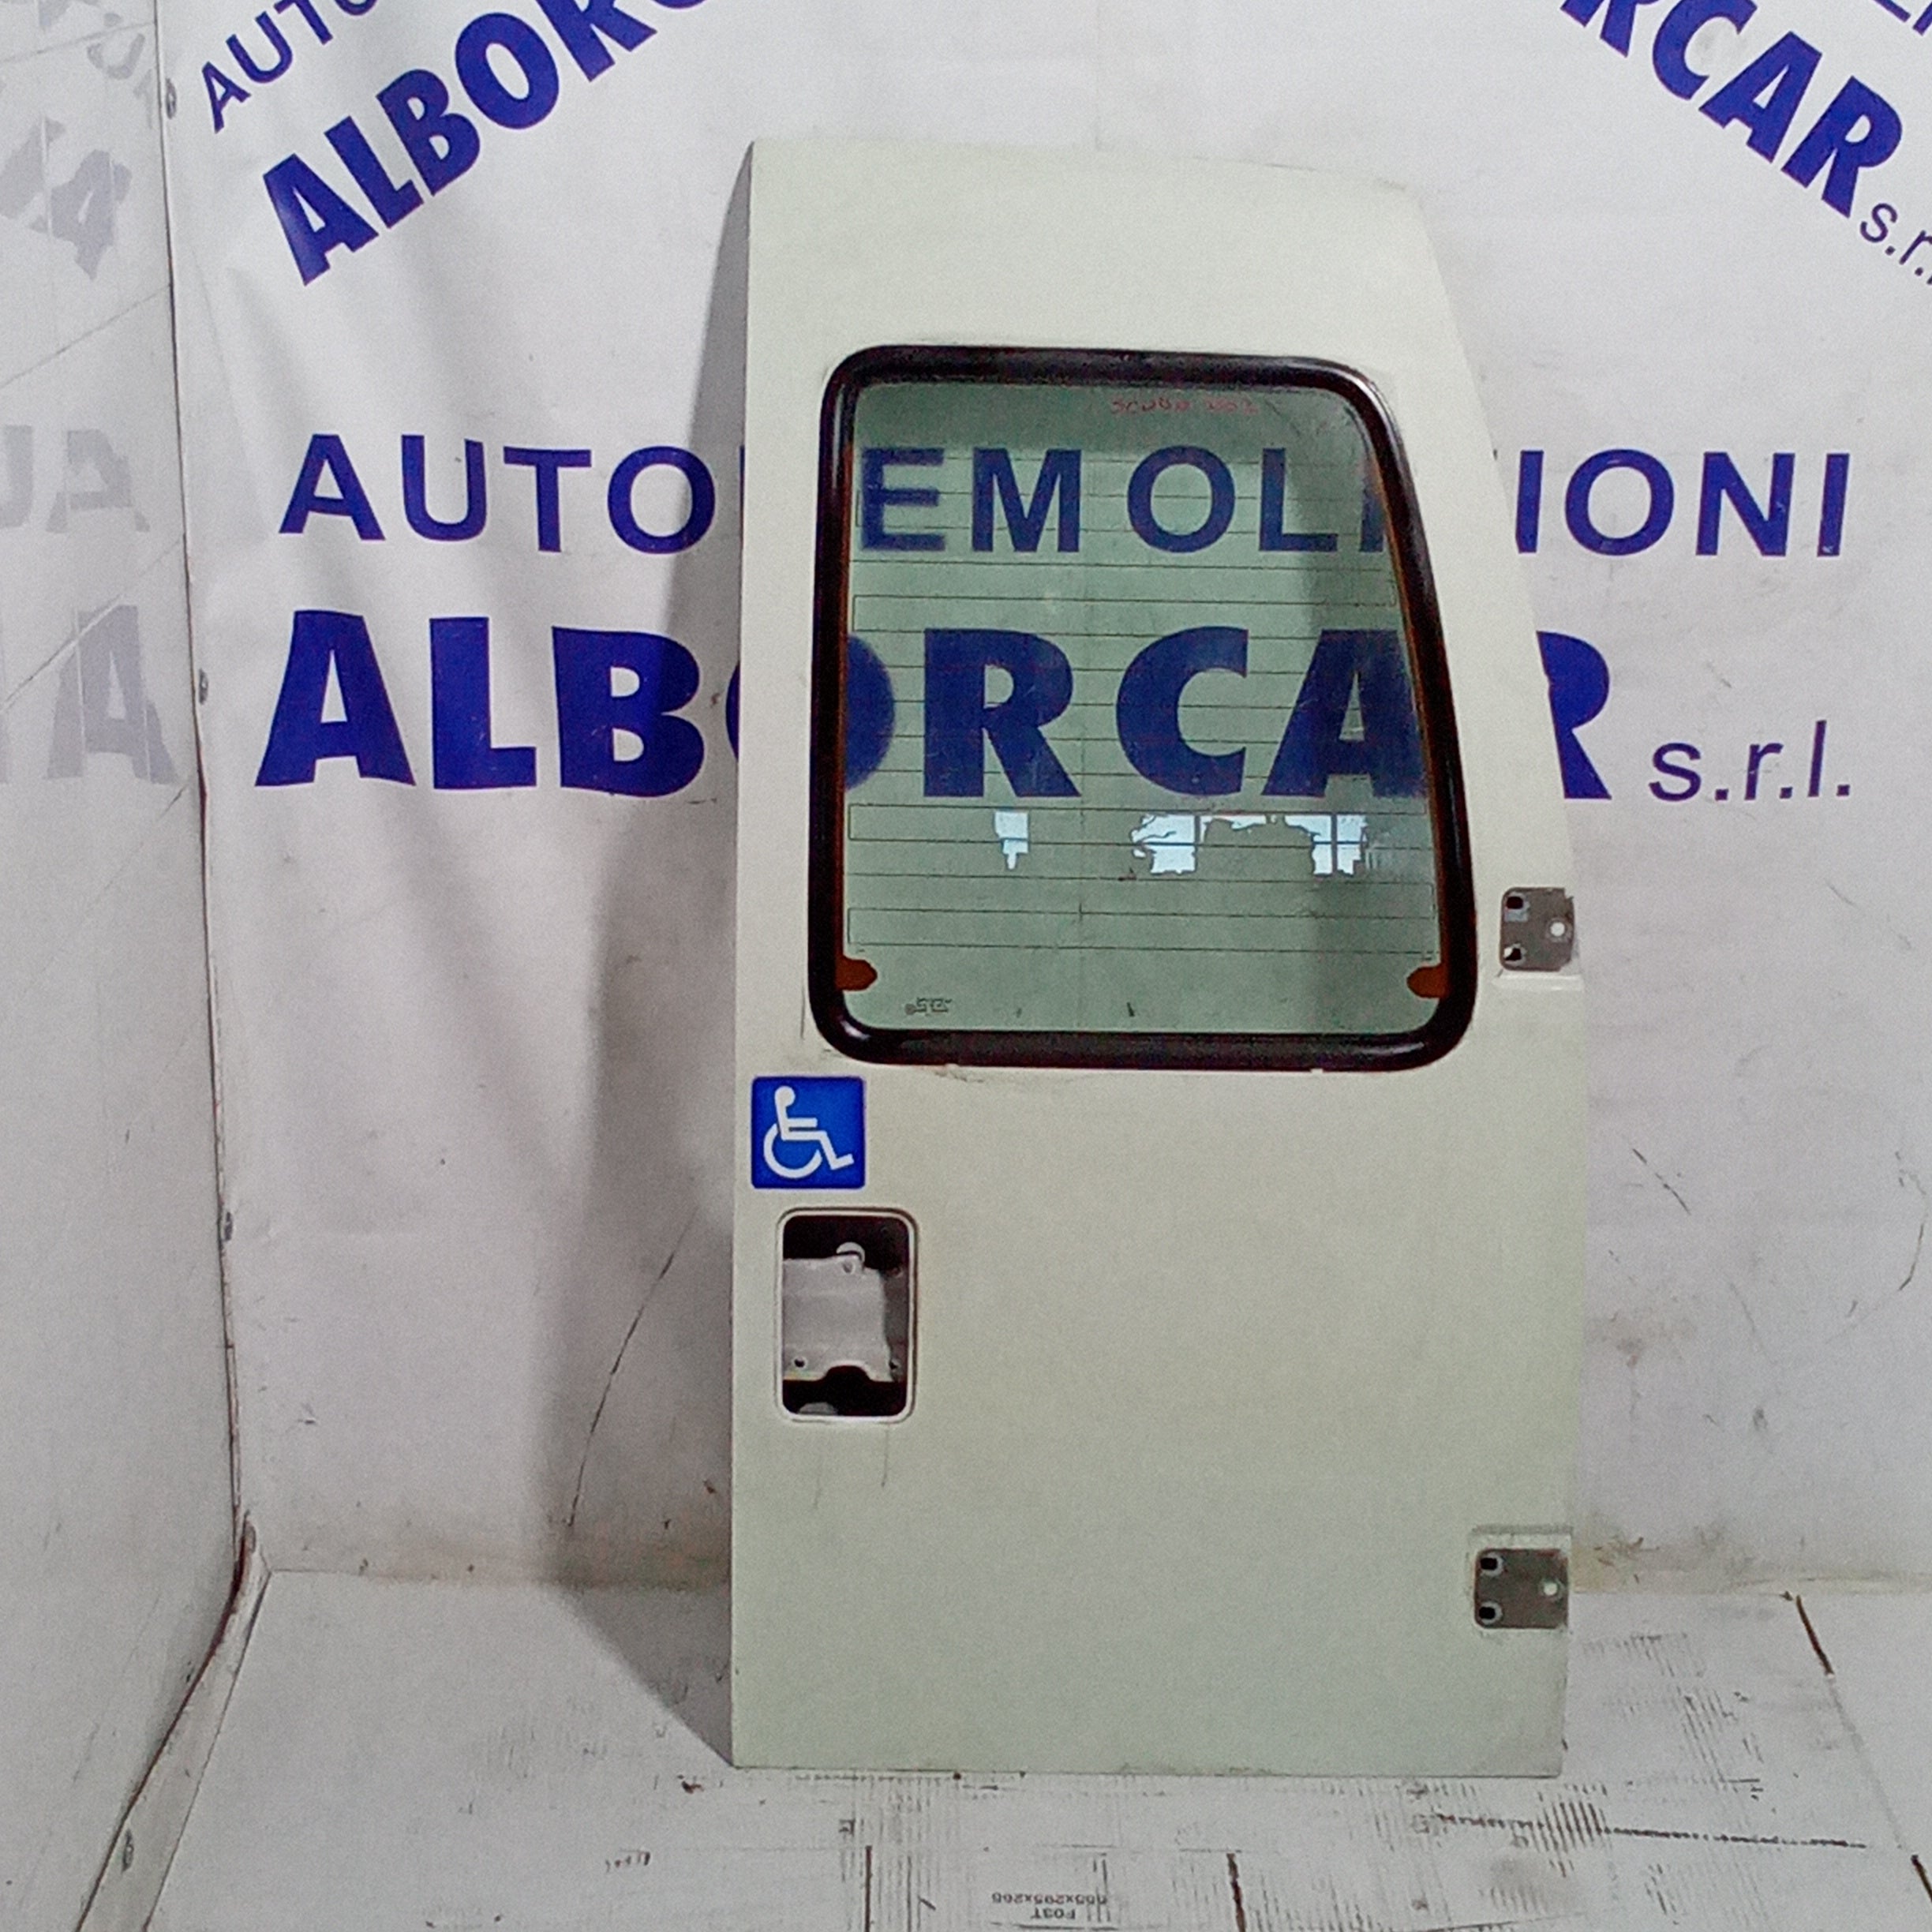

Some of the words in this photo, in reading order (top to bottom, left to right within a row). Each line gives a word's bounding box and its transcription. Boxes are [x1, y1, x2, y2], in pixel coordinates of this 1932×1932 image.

[201, 0, 377, 133] AUT
[263, 0, 706, 286] ALBOR
[1859, 203, 1932, 285] s.r.
[1648, 719, 1852, 802] s.r.l.
